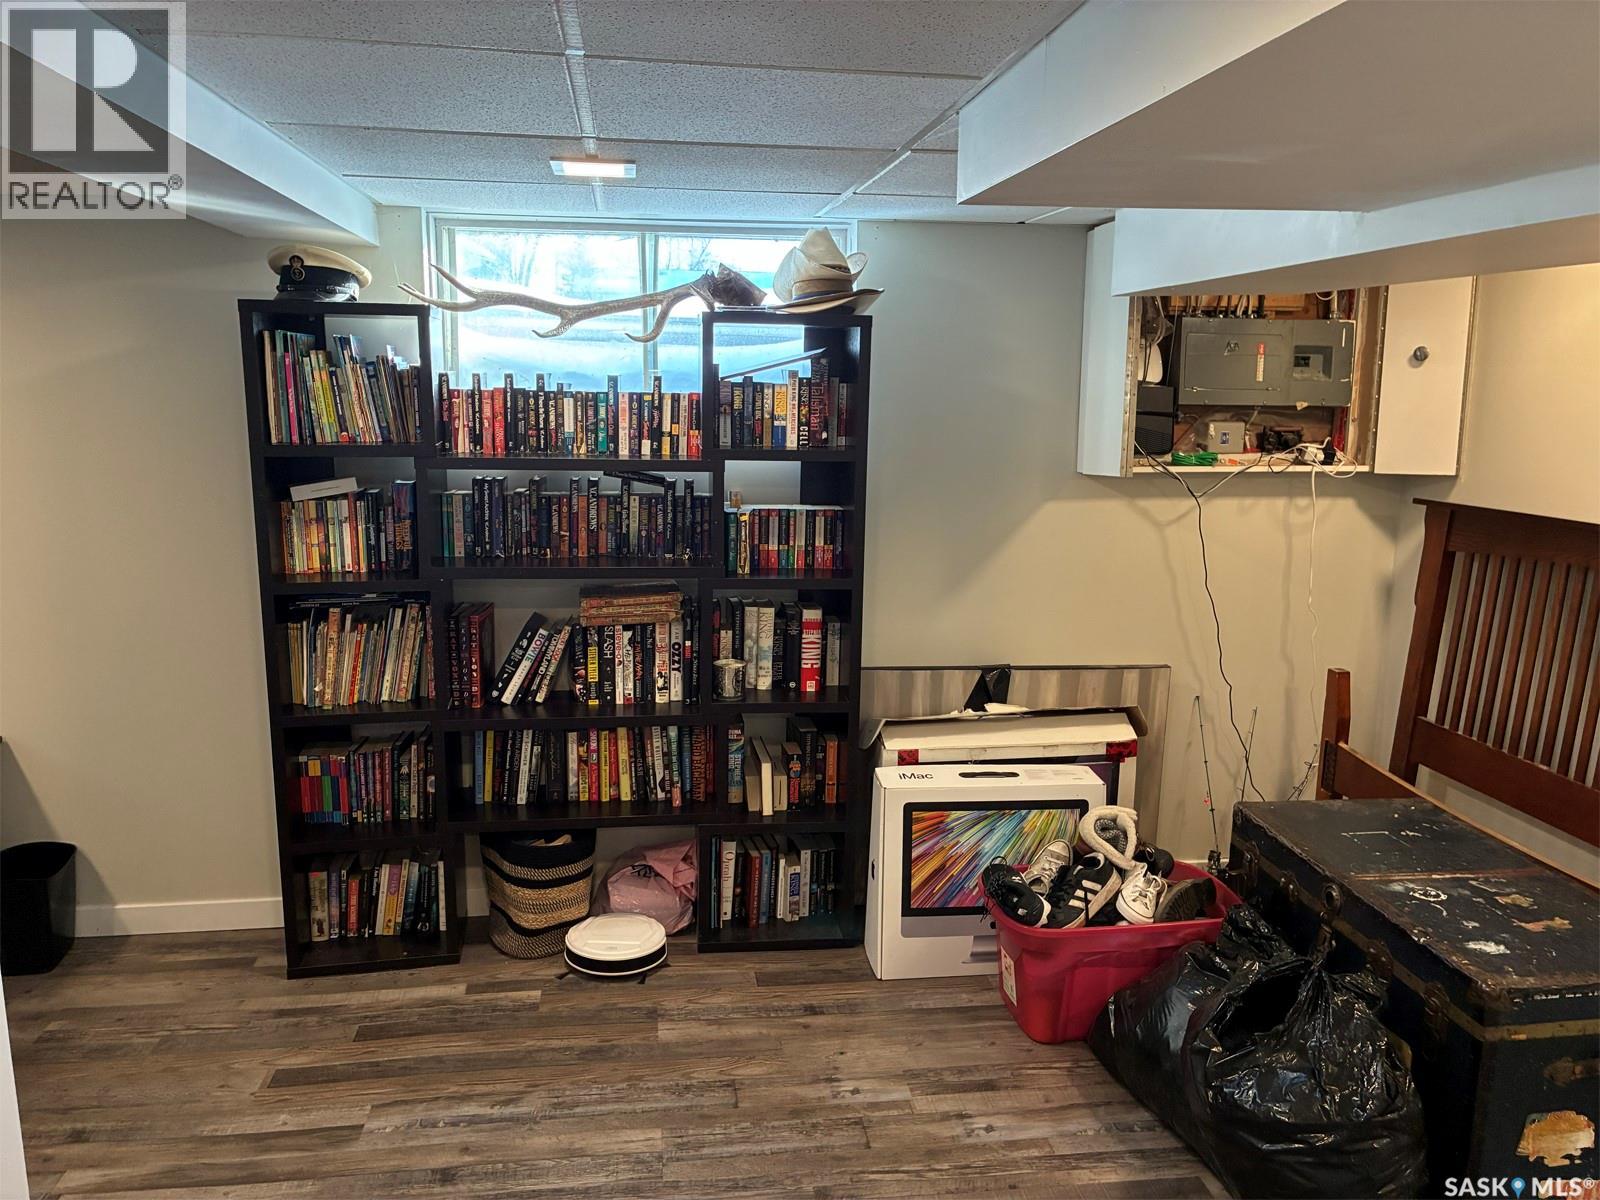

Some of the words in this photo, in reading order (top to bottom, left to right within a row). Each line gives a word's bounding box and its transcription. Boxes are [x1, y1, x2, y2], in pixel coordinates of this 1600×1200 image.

[799, 426, 809, 445] CELL
[394, 523, 403, 550] THINGS
[524, 632, 546, 664] BOWIE
[603, 626, 614, 658] SLASH
[671, 641, 682, 674] OZZY
[801, 634, 821, 668] KING
[898, 772, 934, 780] iMac
[723, 851, 735, 883] Oprah
